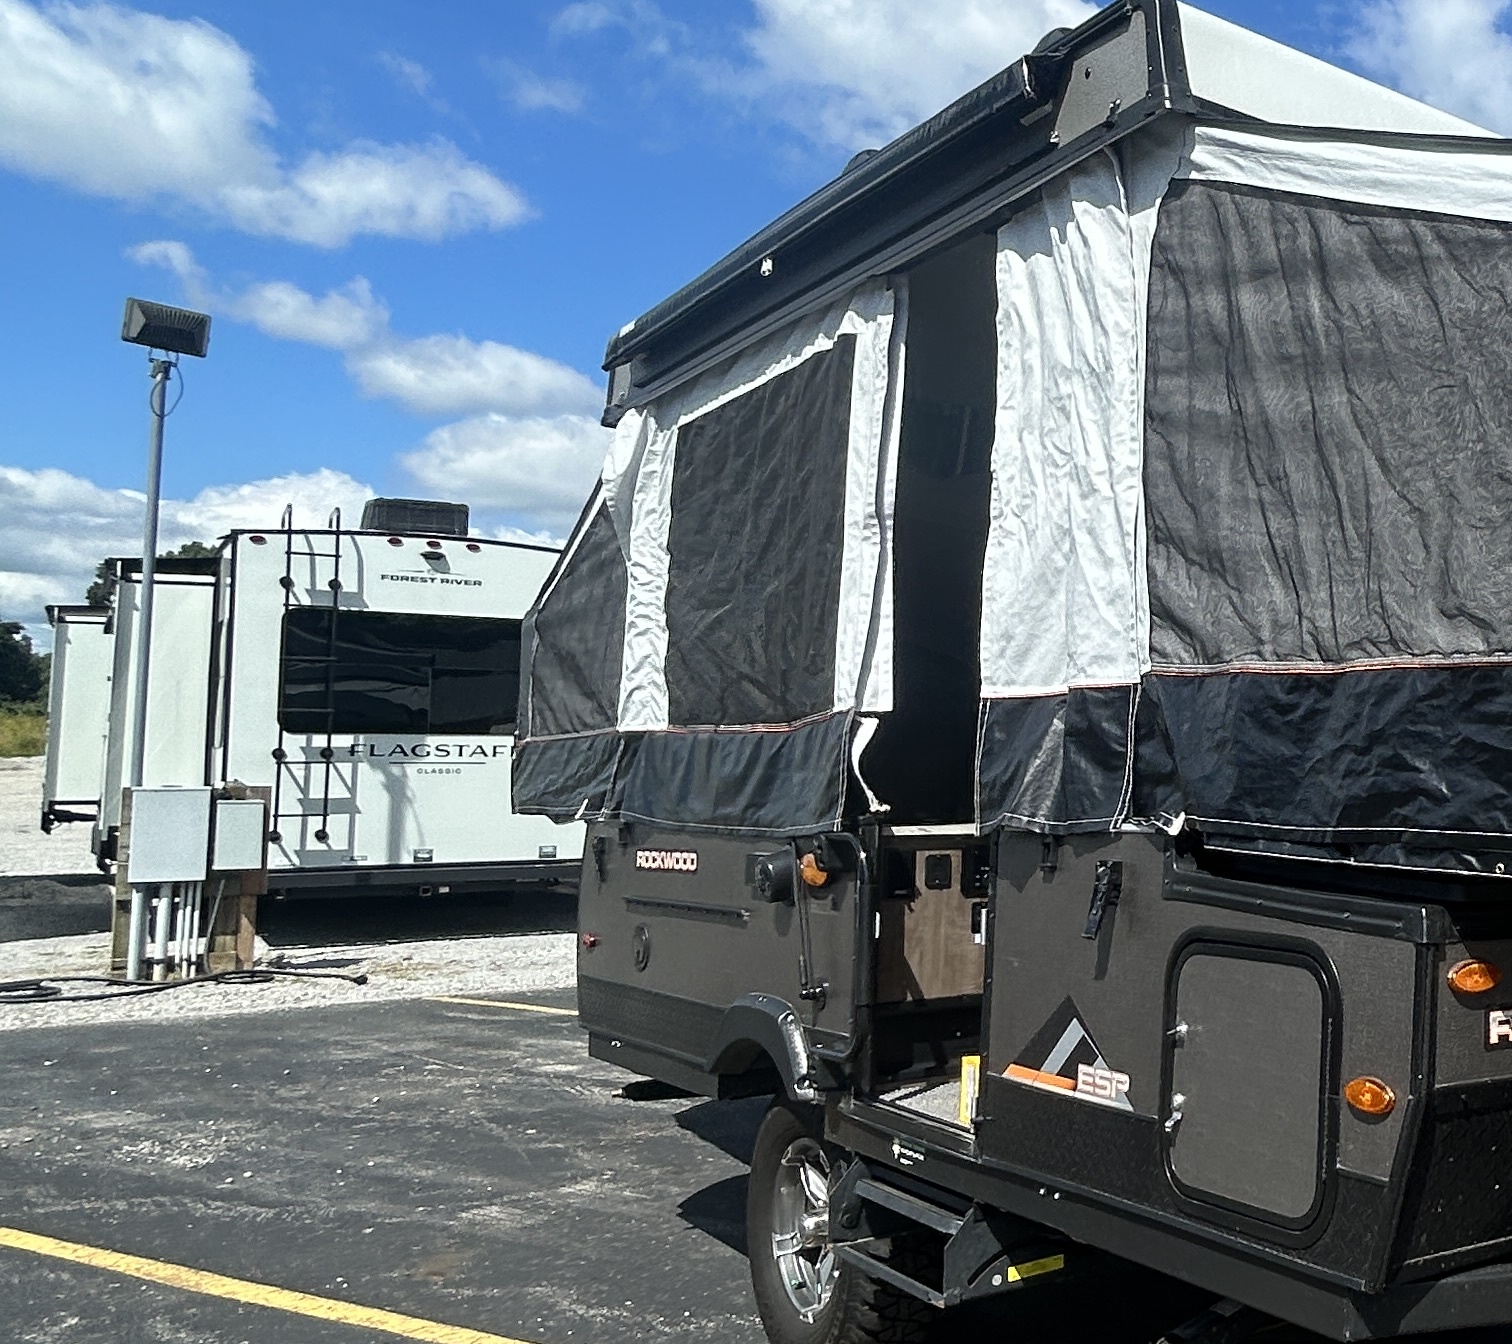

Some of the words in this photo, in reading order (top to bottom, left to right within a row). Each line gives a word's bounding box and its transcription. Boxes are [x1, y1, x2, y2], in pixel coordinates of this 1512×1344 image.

[381, 574, 437, 584] FOREST
[440, 577, 482, 586] RIVER
[416, 767, 462, 775] CLASSIC
[636, 850, 698, 871] ROCKWOOD
[1077, 1062, 1130, 1100] ESP
